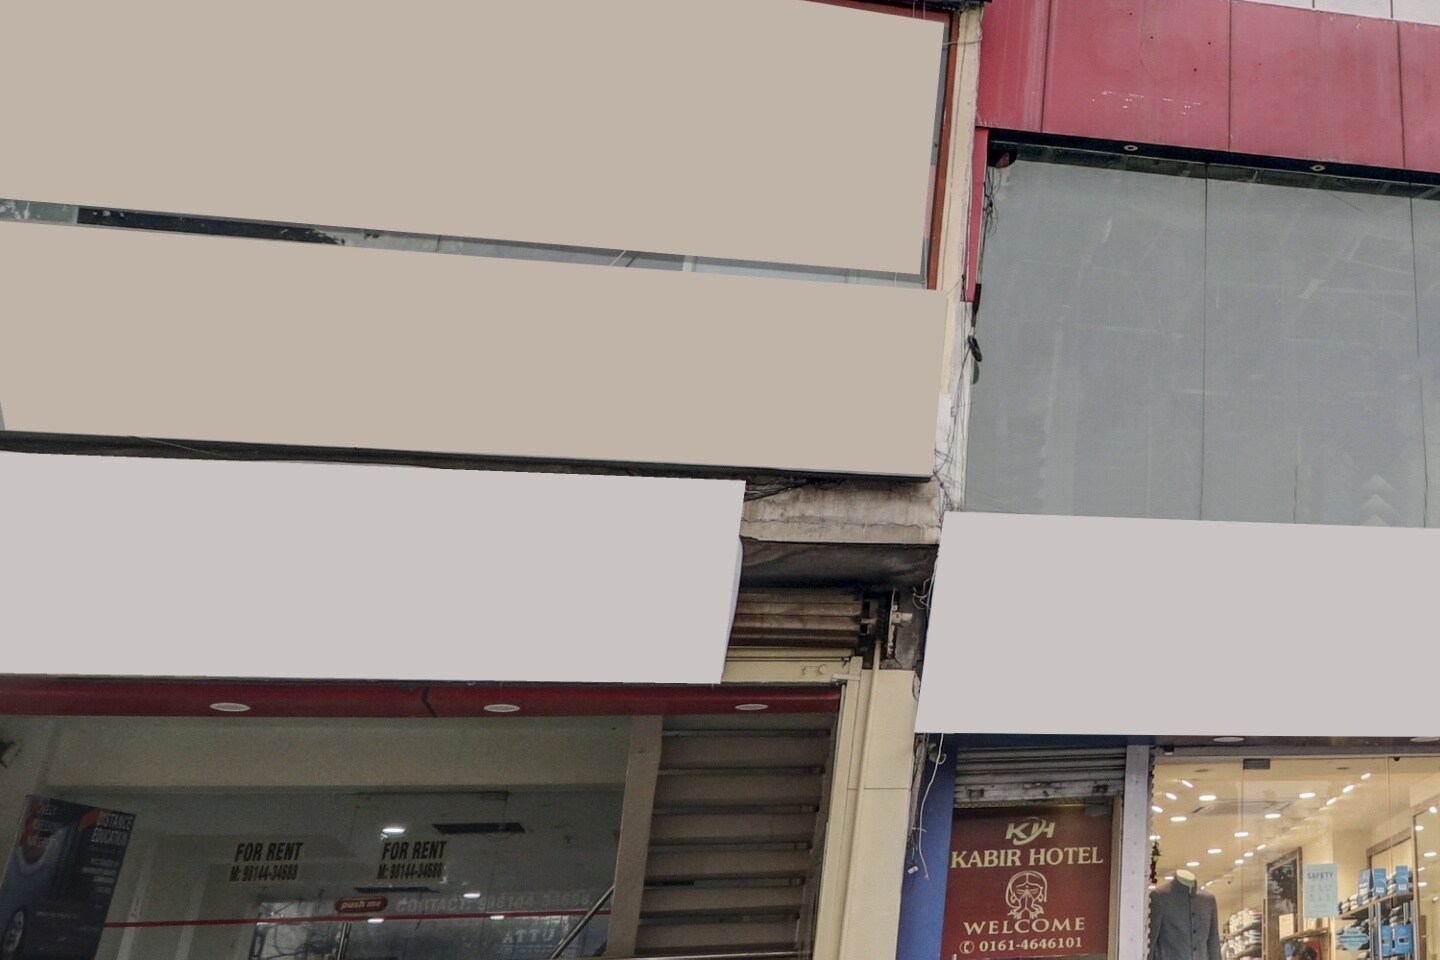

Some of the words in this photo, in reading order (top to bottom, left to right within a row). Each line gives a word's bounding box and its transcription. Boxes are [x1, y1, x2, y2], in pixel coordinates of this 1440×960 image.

[234, 843, 262, 862] FOR
[266, 842, 304, 862] RENT
[381, 841, 409, 860] FOR
[412, 841, 447, 860] RENT
[950, 848, 1022, 869] KABIR
[1028, 847, 1104, 867] HOTEL
[1307, 871, 1334, 879] SAFETY
[341, 899, 365, 910] push
[366, 900, 382, 908] me
[963, 917, 1086, 936] WELCOME
[979, 937, 1082, 953] 0161-4646101
